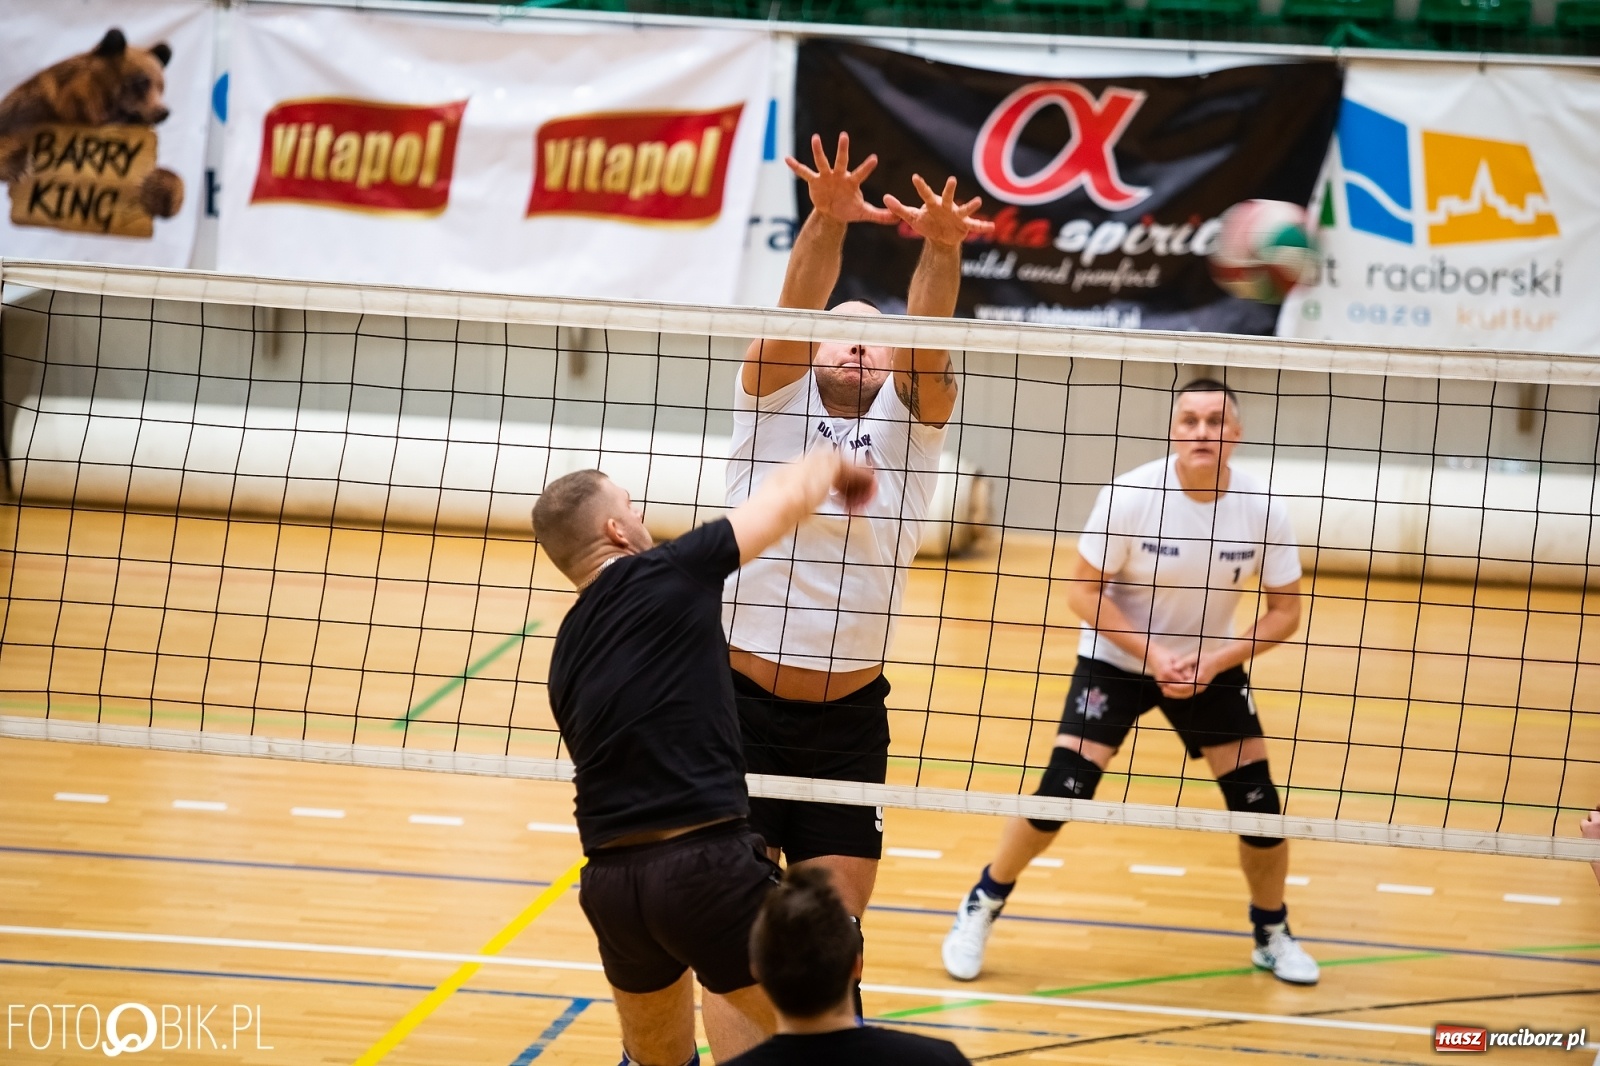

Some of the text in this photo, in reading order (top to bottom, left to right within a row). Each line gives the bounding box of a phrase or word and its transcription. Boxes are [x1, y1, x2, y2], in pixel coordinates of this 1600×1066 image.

[31, 130, 144, 178] BARRY
[271, 122, 446, 190] Vitapol
[543, 126, 723, 200] Vitapol
[27, 179, 120, 232] KING
[1364, 255, 1564, 297] raciborski
[1233, 566, 1242, 584] 1
